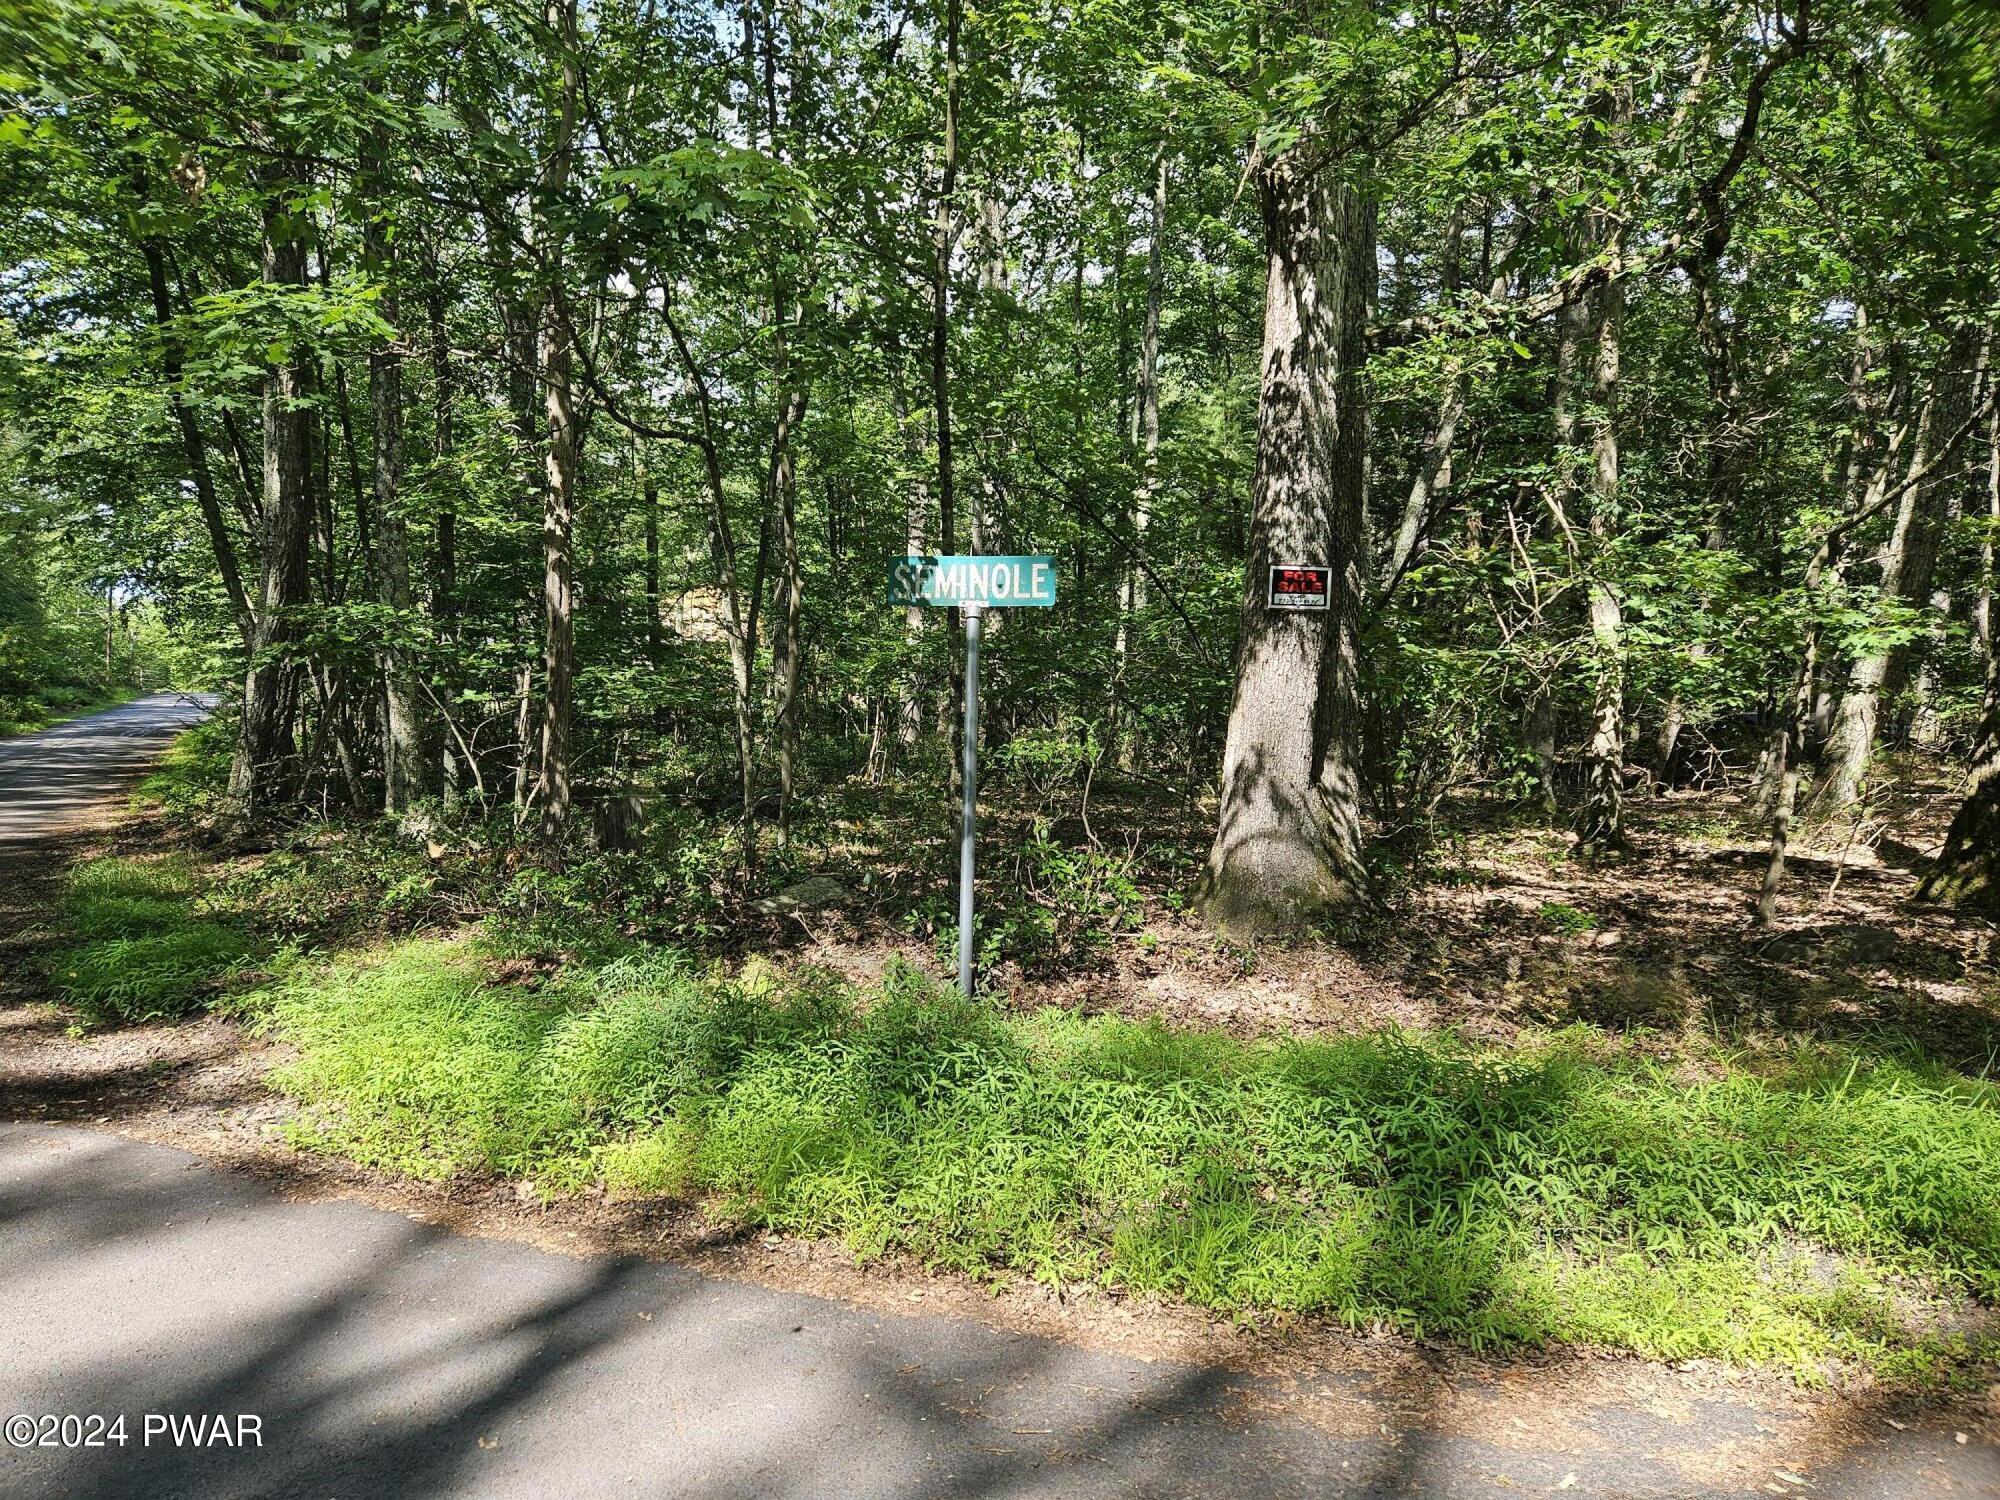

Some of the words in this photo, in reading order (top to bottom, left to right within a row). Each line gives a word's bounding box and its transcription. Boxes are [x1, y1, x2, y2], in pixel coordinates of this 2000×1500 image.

[894, 563, 1049, 599] SEMINOLE
[1284, 571, 1317, 582] FOR
[1279, 582, 1322, 593] SALE
